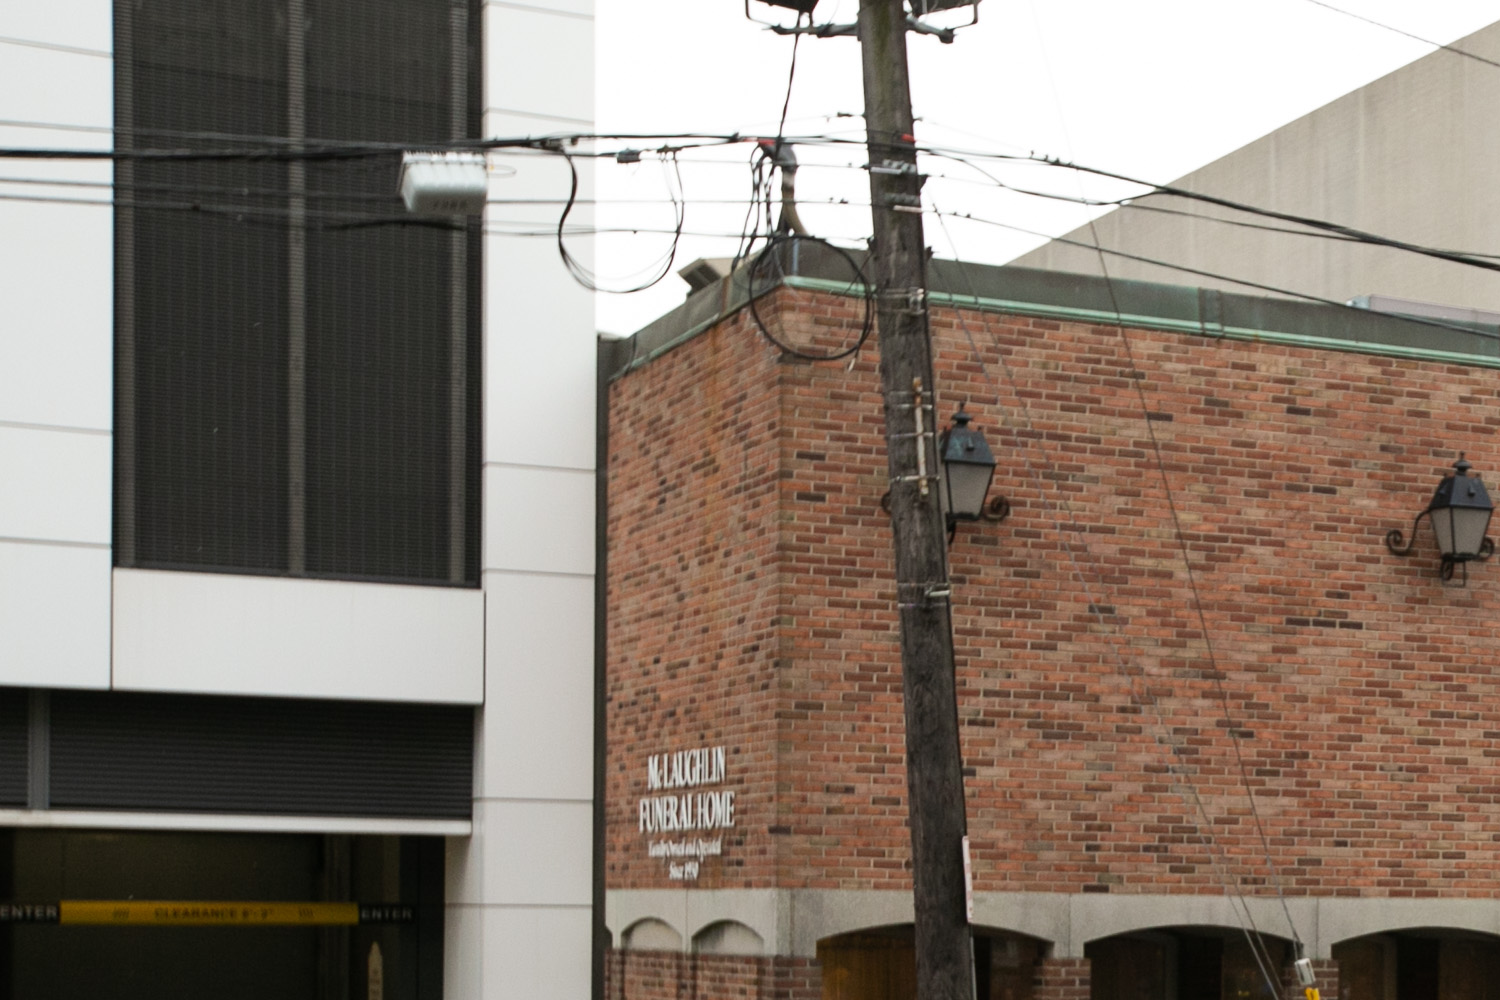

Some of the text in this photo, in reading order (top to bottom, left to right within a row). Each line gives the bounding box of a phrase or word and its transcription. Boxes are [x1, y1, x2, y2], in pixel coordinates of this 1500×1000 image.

[639, 791, 736, 834] FUNERAL HOME
[0, 904, 58, 919] ENTER
